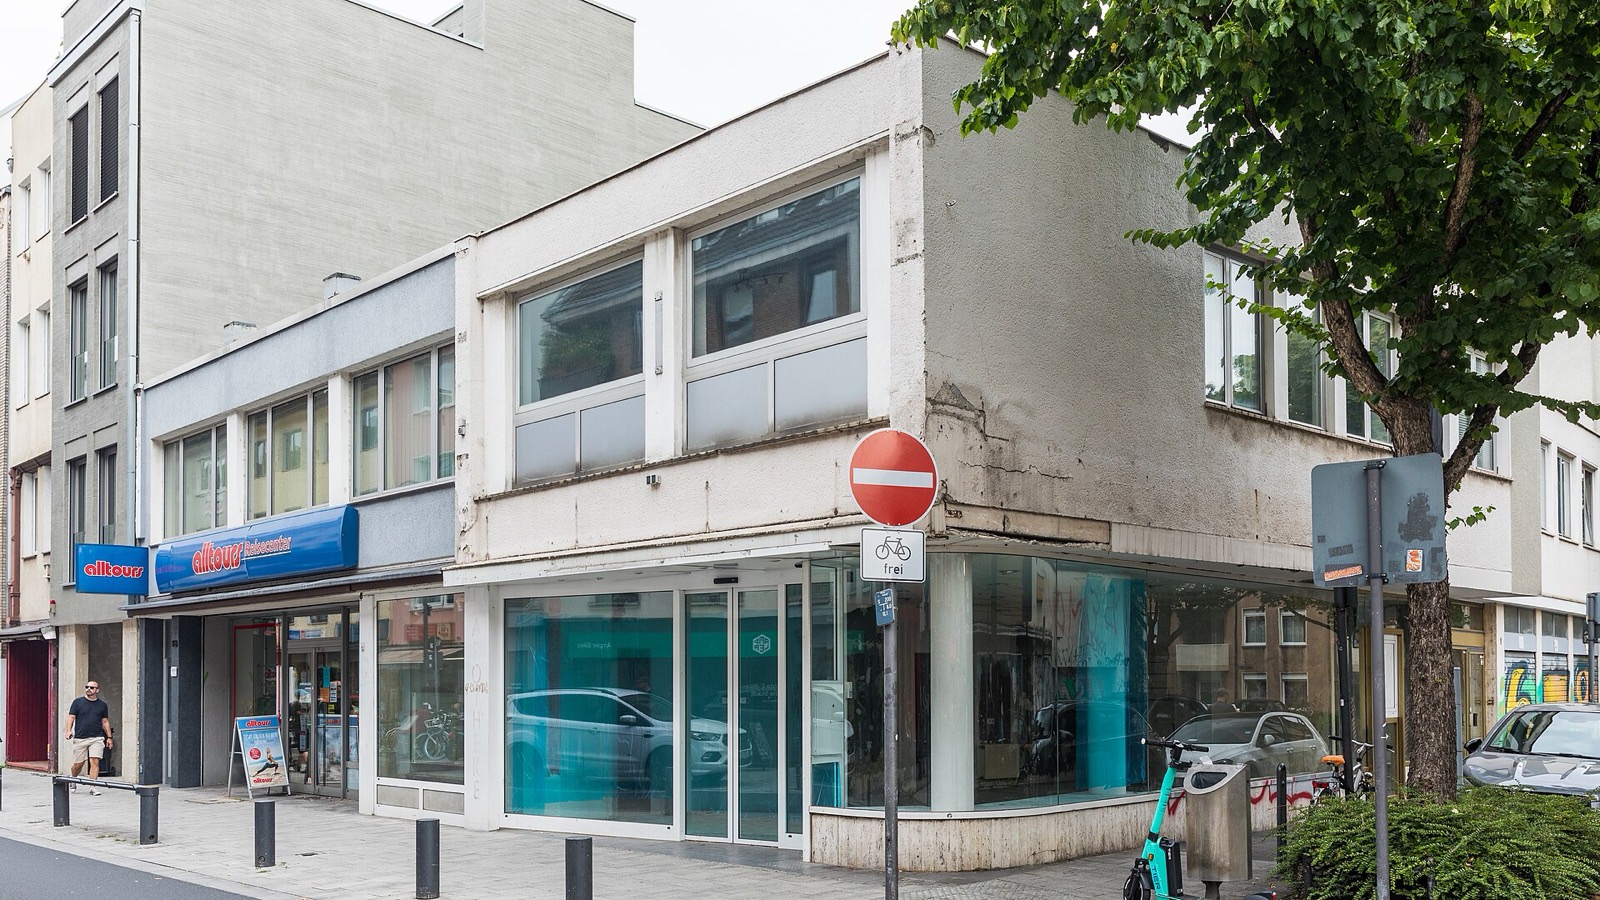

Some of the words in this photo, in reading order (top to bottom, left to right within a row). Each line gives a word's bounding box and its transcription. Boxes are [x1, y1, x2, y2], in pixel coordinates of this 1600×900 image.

[192, 541, 243, 575] alltours
[244, 534, 292, 557] Reisecenter
[84, 560, 144, 578] alltours
[884, 563, 903, 575] frei
[245, 719, 271, 728] alltours
[253, 777, 273, 785] alltours
[1152, 865, 1161, 890] TIER
